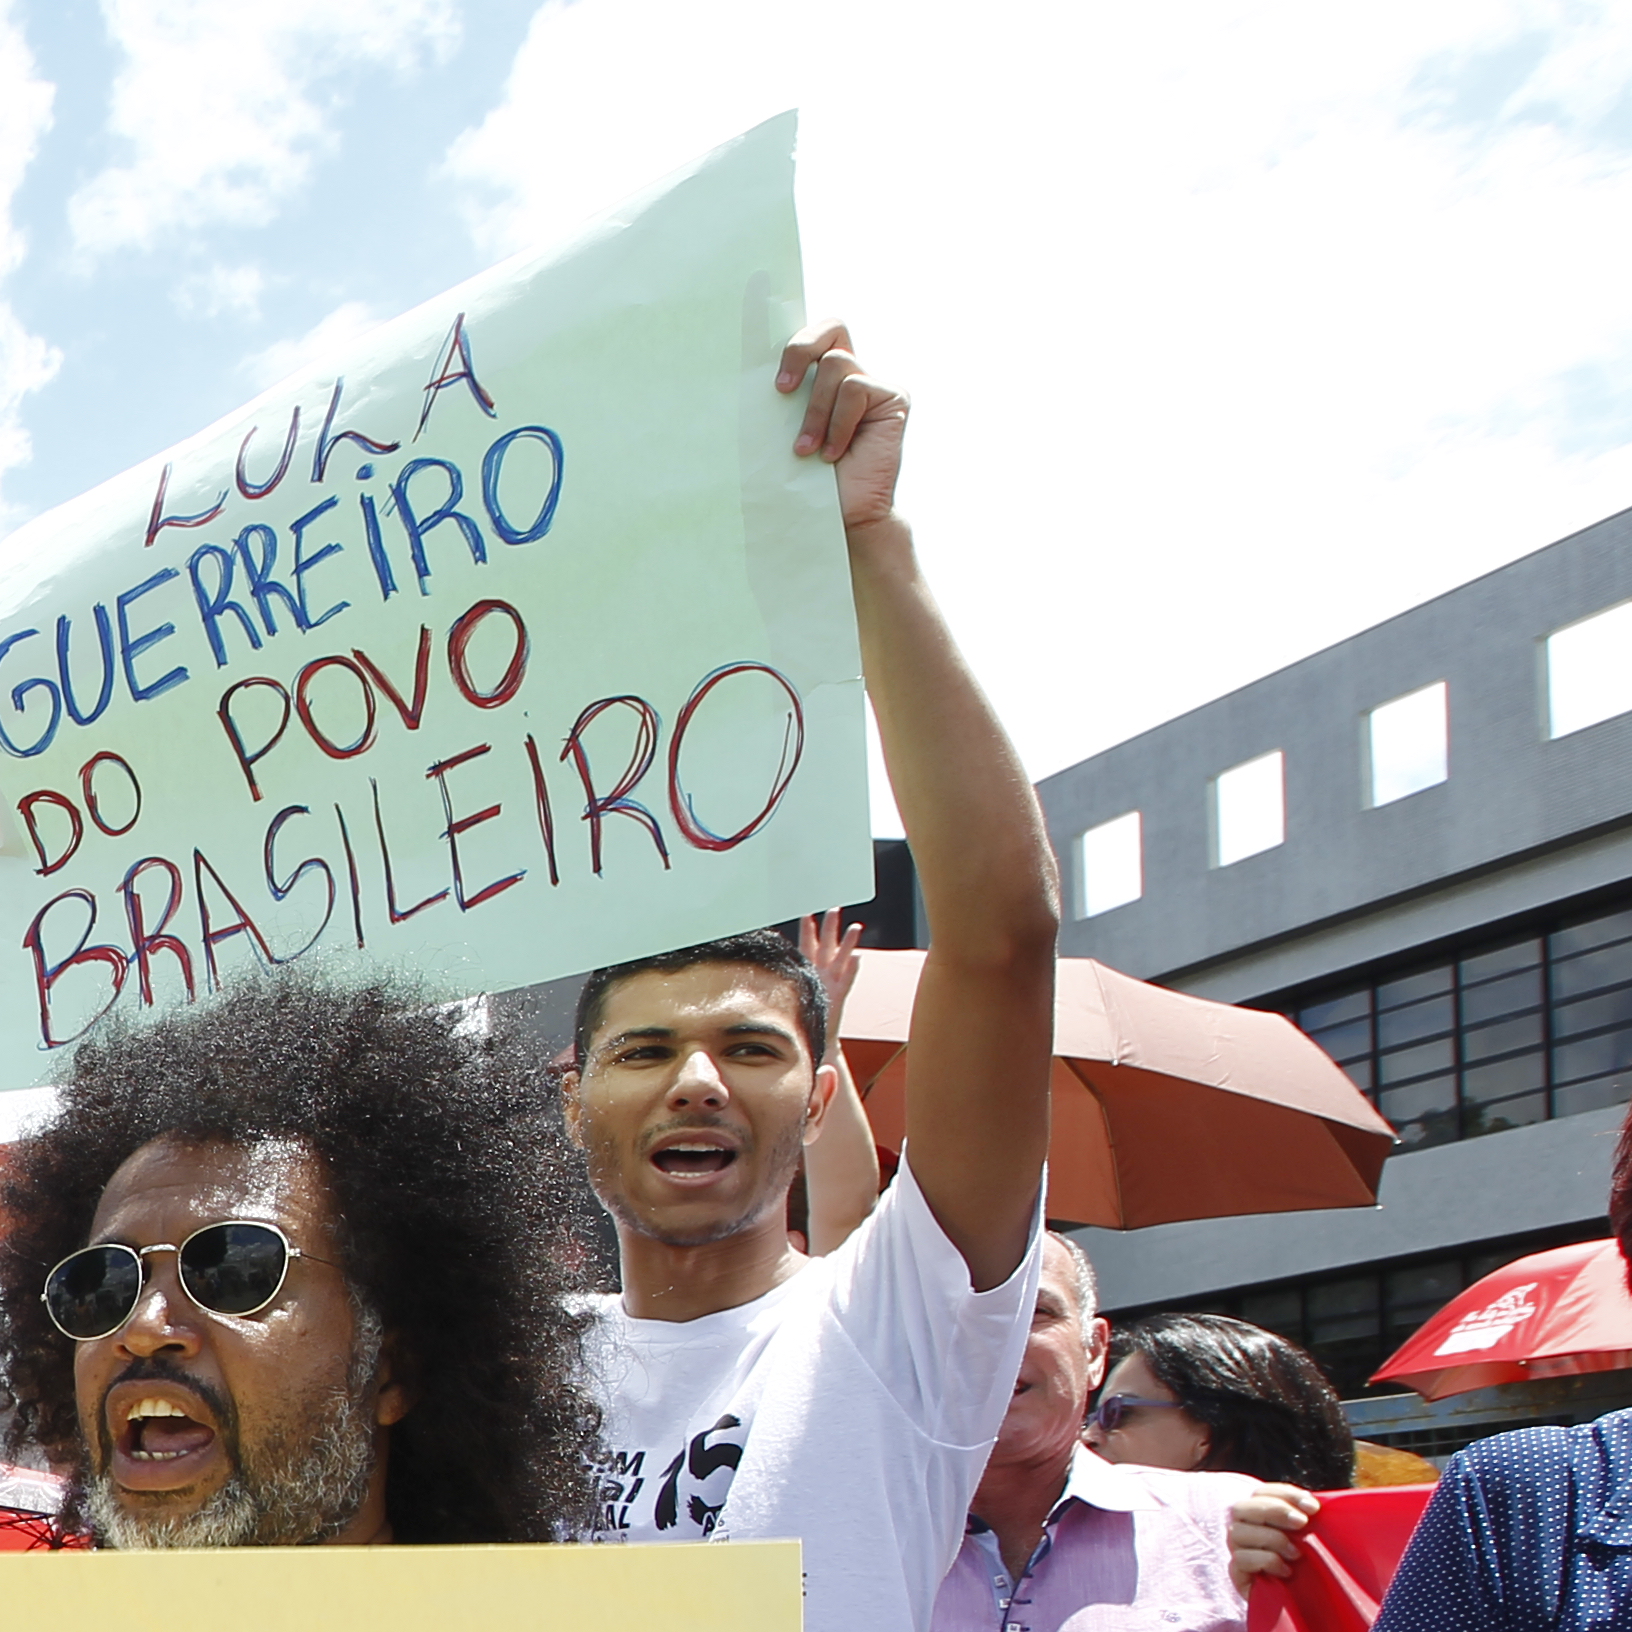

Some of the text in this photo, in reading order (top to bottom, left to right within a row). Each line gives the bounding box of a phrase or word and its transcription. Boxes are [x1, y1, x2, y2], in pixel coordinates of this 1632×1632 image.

[143, 311, 499, 548] LULA
[15, 598, 529, 876] DO POVO
[21, 660, 805, 1050] BRASILEIRO
